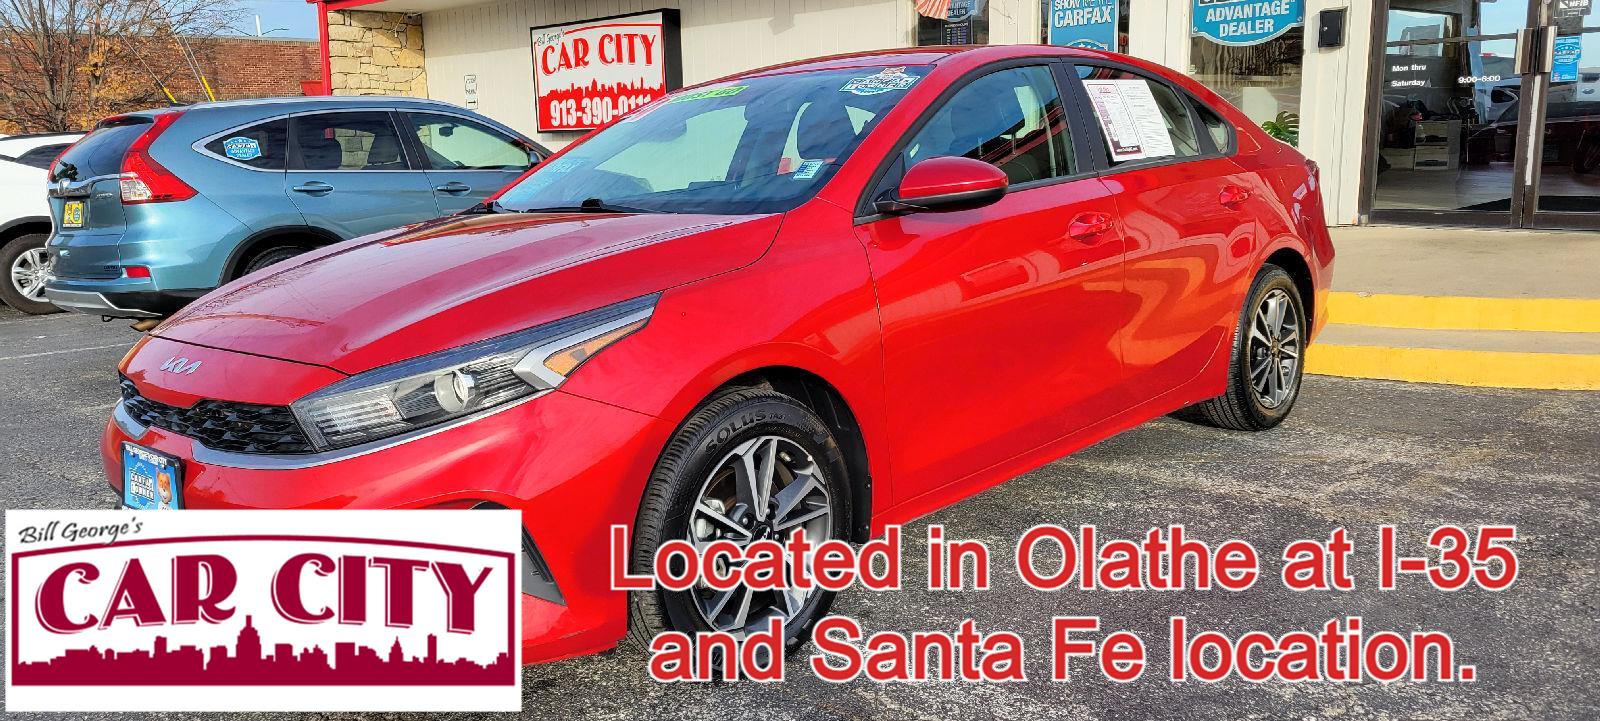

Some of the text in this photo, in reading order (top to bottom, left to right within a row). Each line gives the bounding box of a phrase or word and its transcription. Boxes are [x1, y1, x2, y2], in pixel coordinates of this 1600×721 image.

[1054, 6, 1112, 28] CARFAX
[1205, 1, 1290, 22] ADVANTAGE
[1219, 19, 1274, 38] DEALER
[541, 33, 656, 76] CAR CITY
[1458, 75, 1500, 84] 9:00-6:00
[551, 94, 652, 126] 913-390-01
[705, 409, 768, 454] SOLUS
